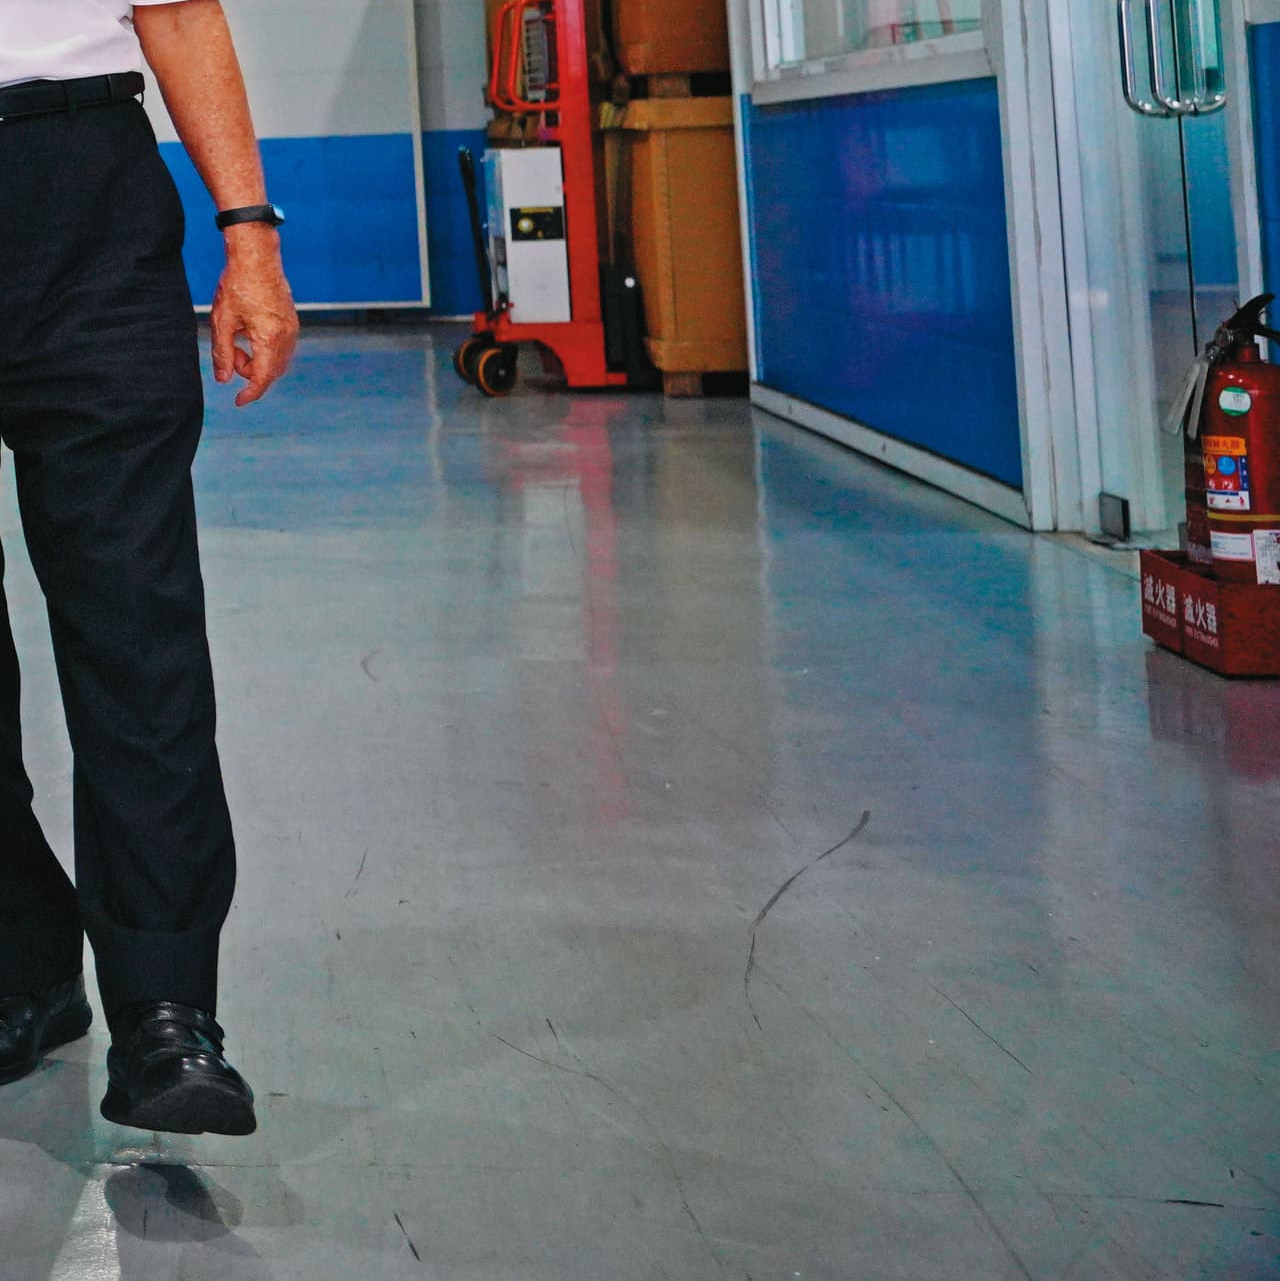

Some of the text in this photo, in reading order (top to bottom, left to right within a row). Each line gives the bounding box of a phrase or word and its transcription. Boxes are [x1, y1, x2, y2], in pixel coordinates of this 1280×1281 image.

[1144, 572, 1176, 615] 滅火器
[1183, 592, 1217, 635] 滅火器
